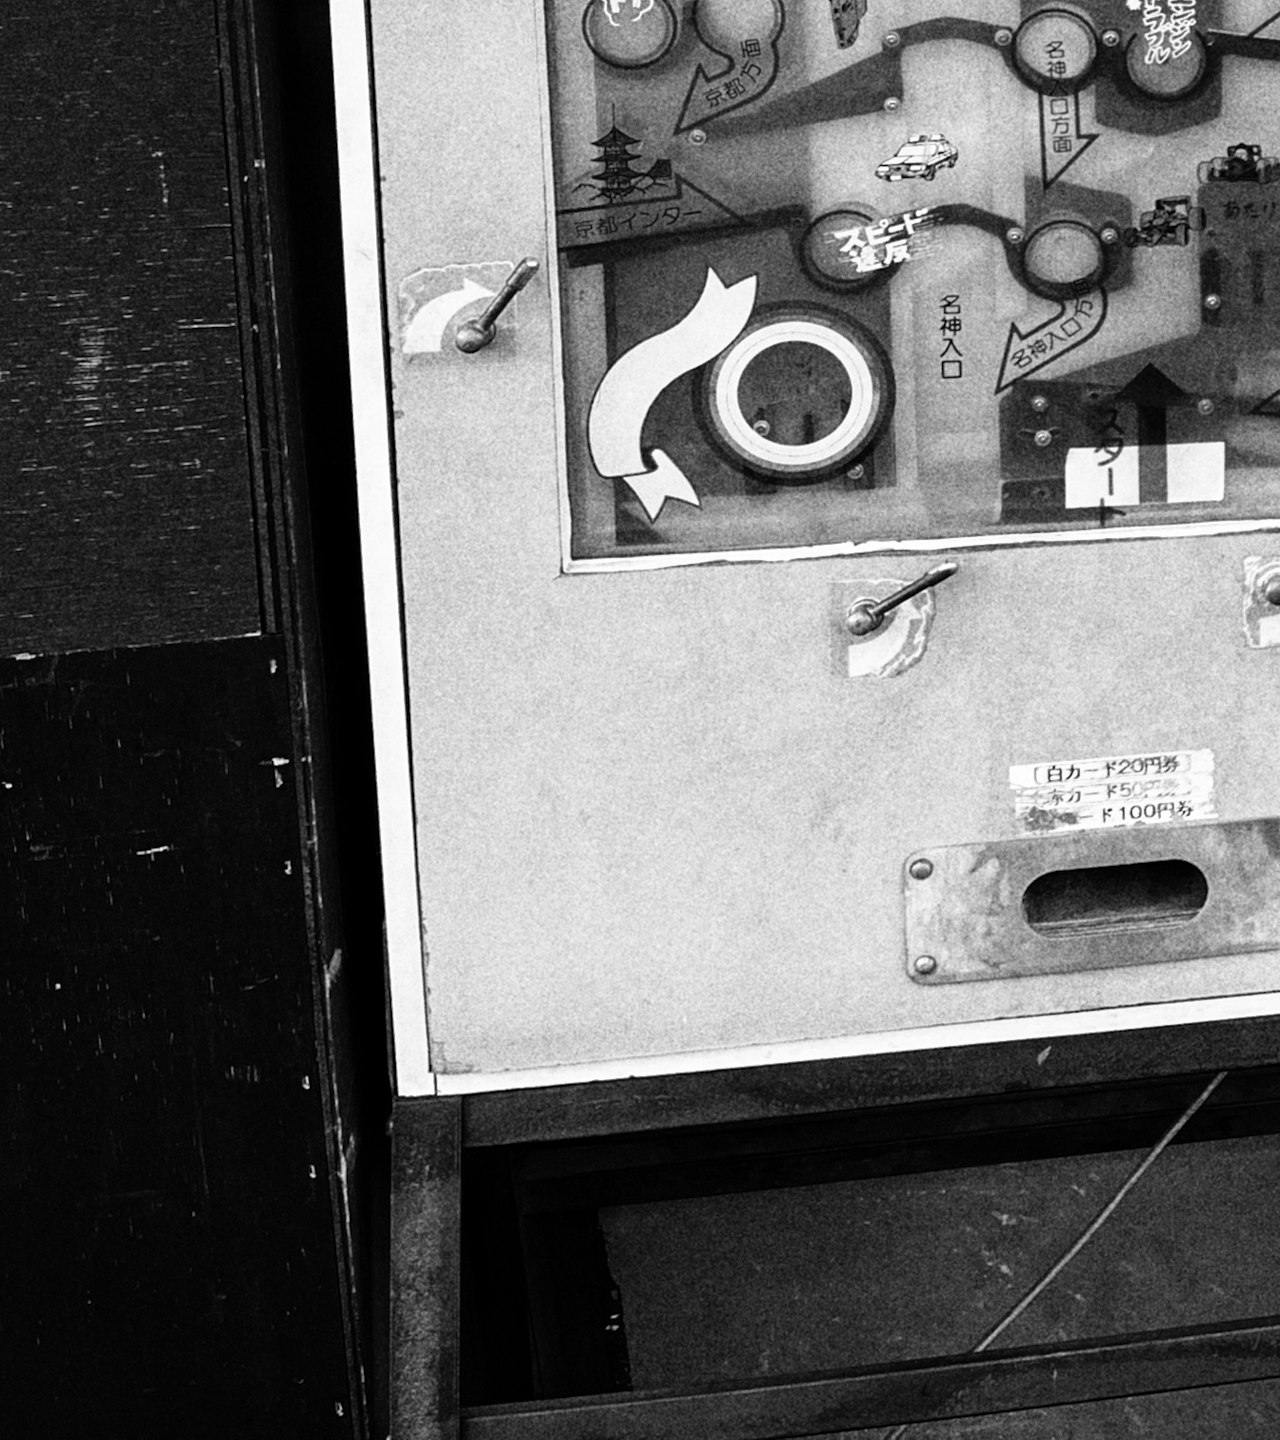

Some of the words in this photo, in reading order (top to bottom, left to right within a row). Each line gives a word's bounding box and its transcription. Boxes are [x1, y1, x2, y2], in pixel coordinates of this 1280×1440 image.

[704, 37, 764, 109] 京都方面
[1044, 40, 1073, 154] 名神入口方面
[574, 207, 702, 237] 京都インター
[834, 208, 929, 253] スピード
[939, 294, 964, 380] 名神入口
[1097, 408, 1128, 528] スタート
[1046, 755, 1182, 784] 白カード20円券
